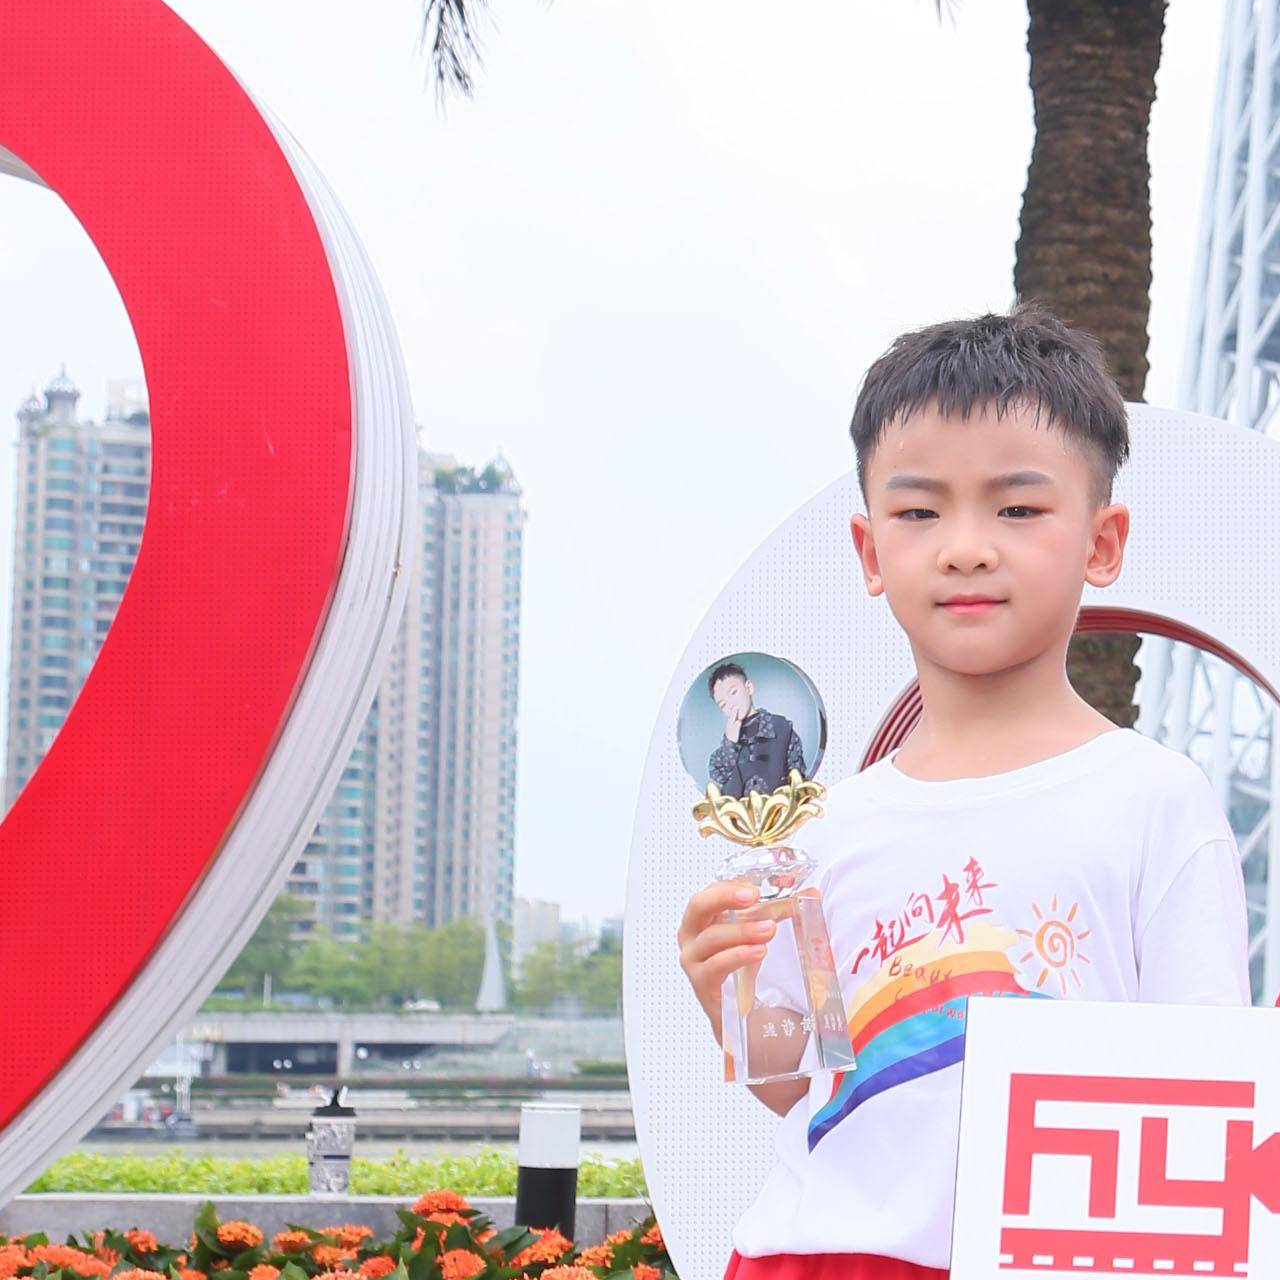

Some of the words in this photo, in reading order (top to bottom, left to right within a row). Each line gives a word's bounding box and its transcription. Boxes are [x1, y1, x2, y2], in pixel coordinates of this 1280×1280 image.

[850, 855, 999, 975] 一起向未来
